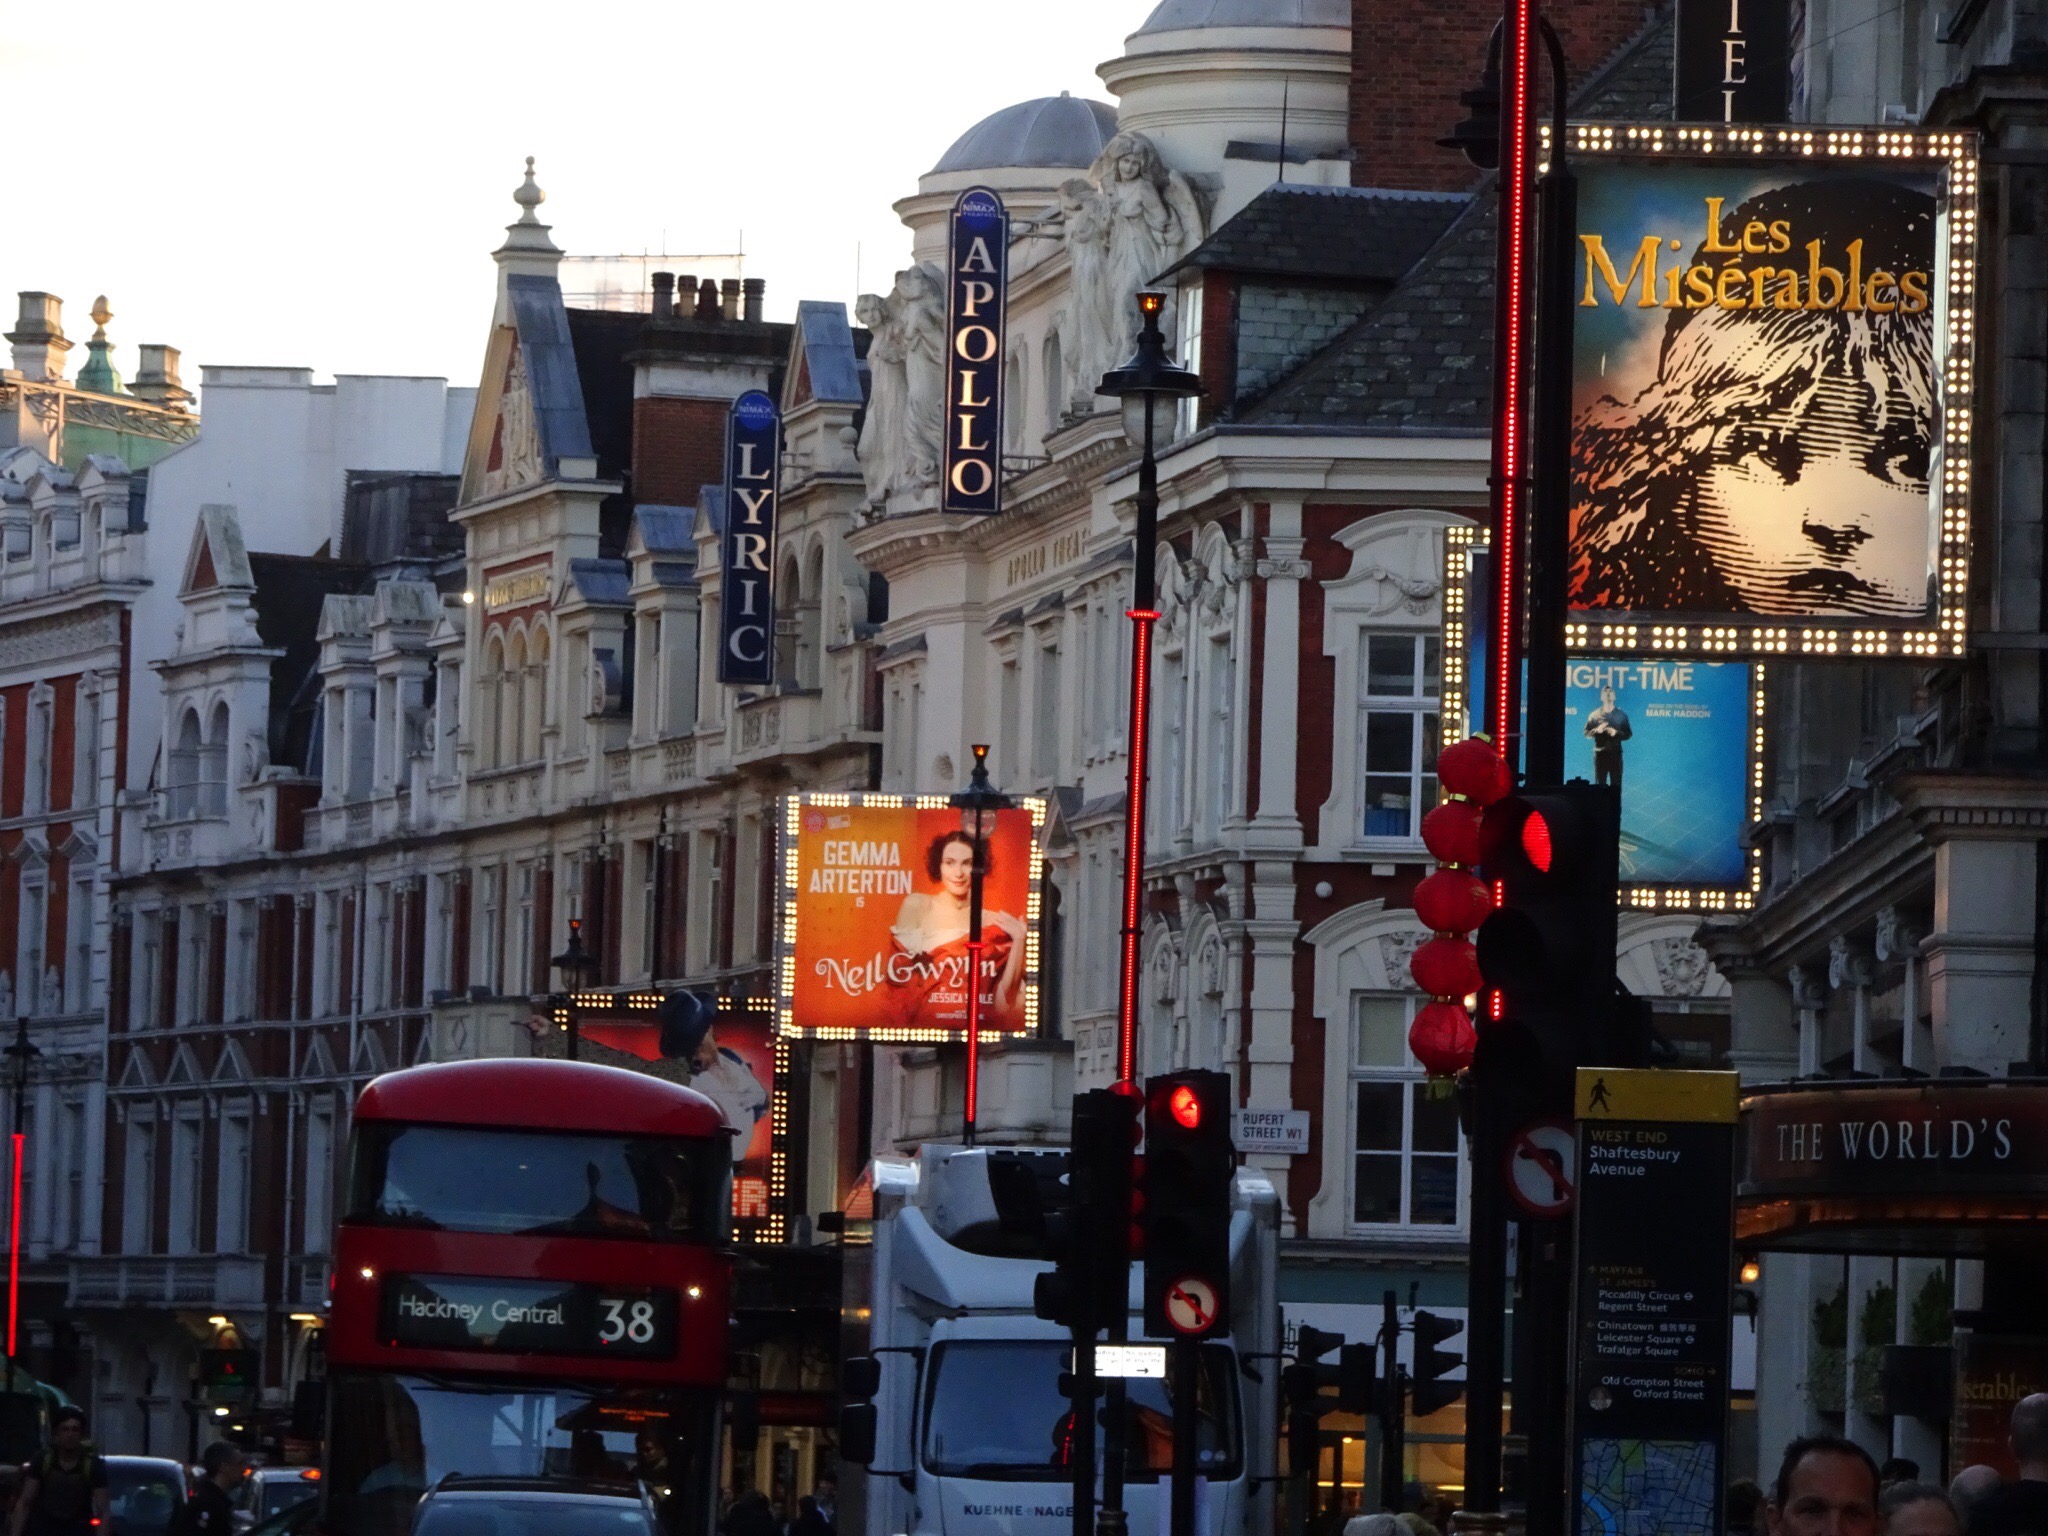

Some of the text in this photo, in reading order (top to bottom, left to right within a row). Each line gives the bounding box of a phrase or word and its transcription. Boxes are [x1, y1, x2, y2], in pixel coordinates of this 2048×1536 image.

[1703, 197, 1791, 253] Les
[1579, 235, 1929, 313] Misérables
[951, 236, 998, 496] APOLLO
[729, 442, 773, 662] LYRIC
[1007, 527, 1091, 587] APOLLO THEAT
[1565, 664, 1695, 692] IGHT-TIME
[1645, 709, 1711, 719] MARK HADDON
[823, 841, 901, 867] GEMMA
[809, 868, 912, 895] ARTERTON
[815, 951, 885, 997] Nell
[928, 991, 964, 1004] JESSICA
[1243, 1113, 1285, 1126] RUPERT
[1243, 1127, 1303, 1140] STREET W1
[1590, 1130, 1668, 1143] WEST END
[1777, 1118, 2013, 1162] THE WORLD'S
[1589, 1145, 1681, 1163] Shaftesbury
[1588, 1162, 1646, 1176] Avenue
[1600, 1265, 1644, 1275] MAYFAIR
[1598, 1290, 1681, 1302] Piccadilly Circus
[1598, 1301, 1668, 1313] Regent Street
[400, 1295, 654, 1344] Hackney Central 38
[1597, 1320, 1655, 1331] Chinatown
[1597, 1333, 1682, 1344] Leicester Square
[1597, 1344, 1679, 1357] Trafalgar Square
[1674, 1366, 1705, 1376] SOHO
[1601, 1376, 1704, 1388] Old Compton Street
[1633, 1389, 1704, 1400] Oxford Street
[963, 1504, 1023, 1516] KUEHNE
[1034, 1506, 1075, 1517] NAGE
